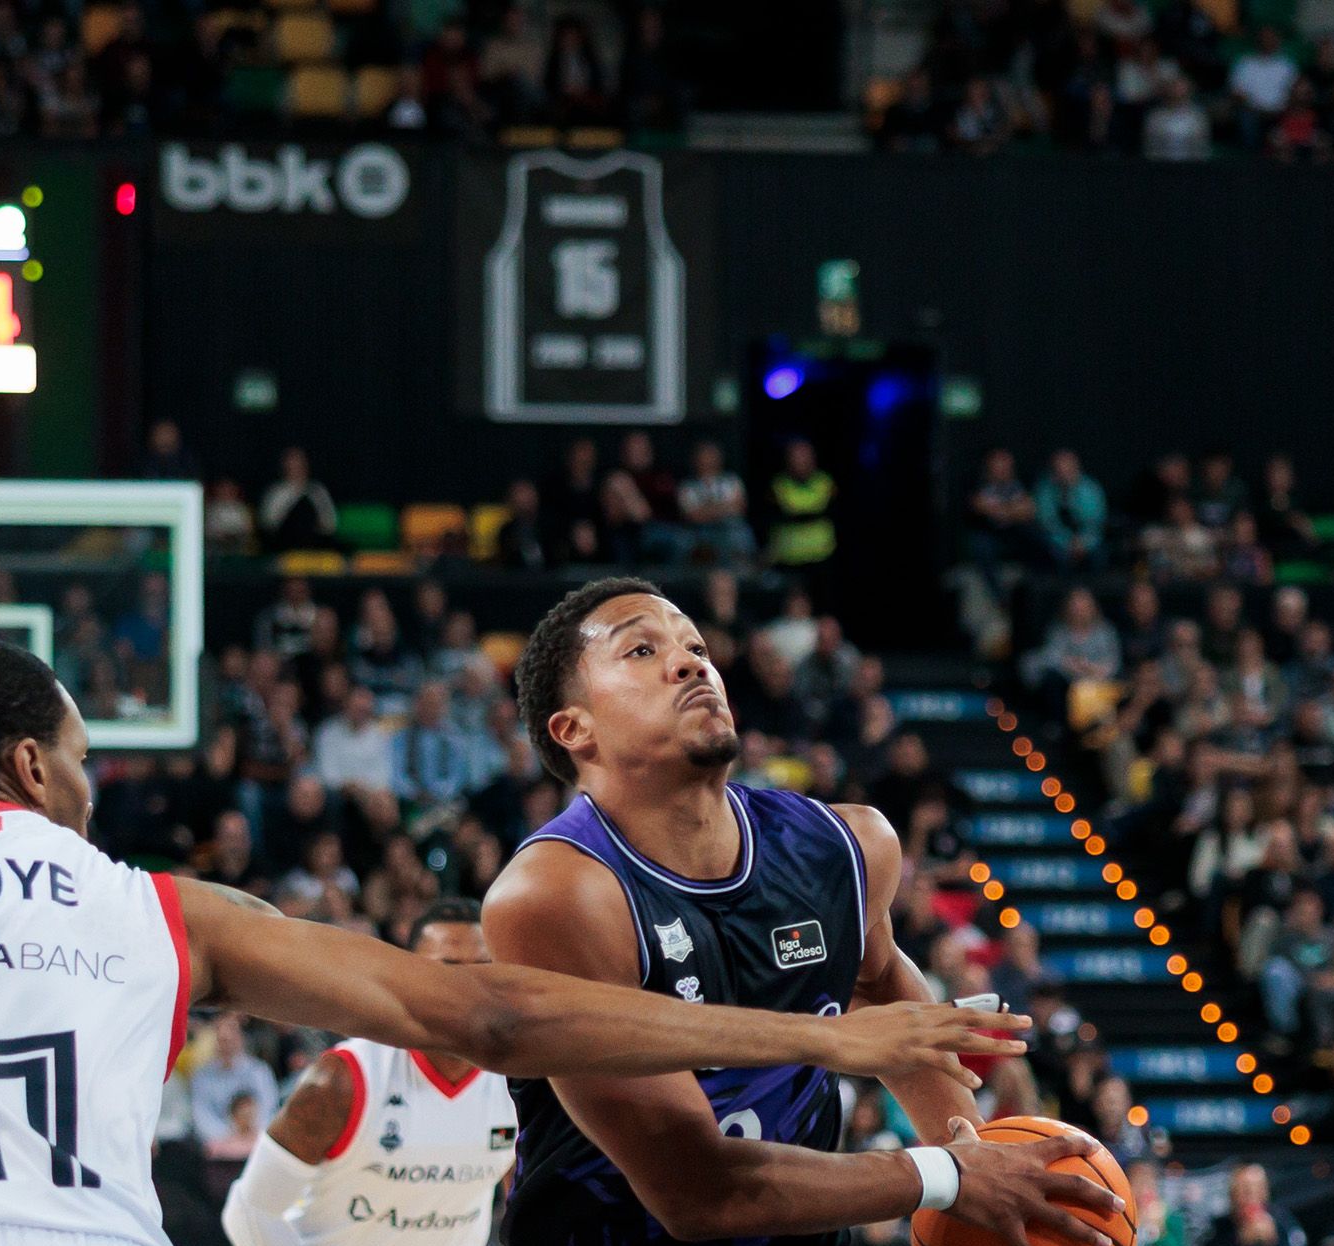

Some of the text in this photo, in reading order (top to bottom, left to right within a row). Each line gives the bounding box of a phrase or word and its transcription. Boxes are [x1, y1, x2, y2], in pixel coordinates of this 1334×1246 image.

[551, 239, 622, 320] 15
[779, 939, 801, 952] liga
[782, 944, 823, 962] endesa
